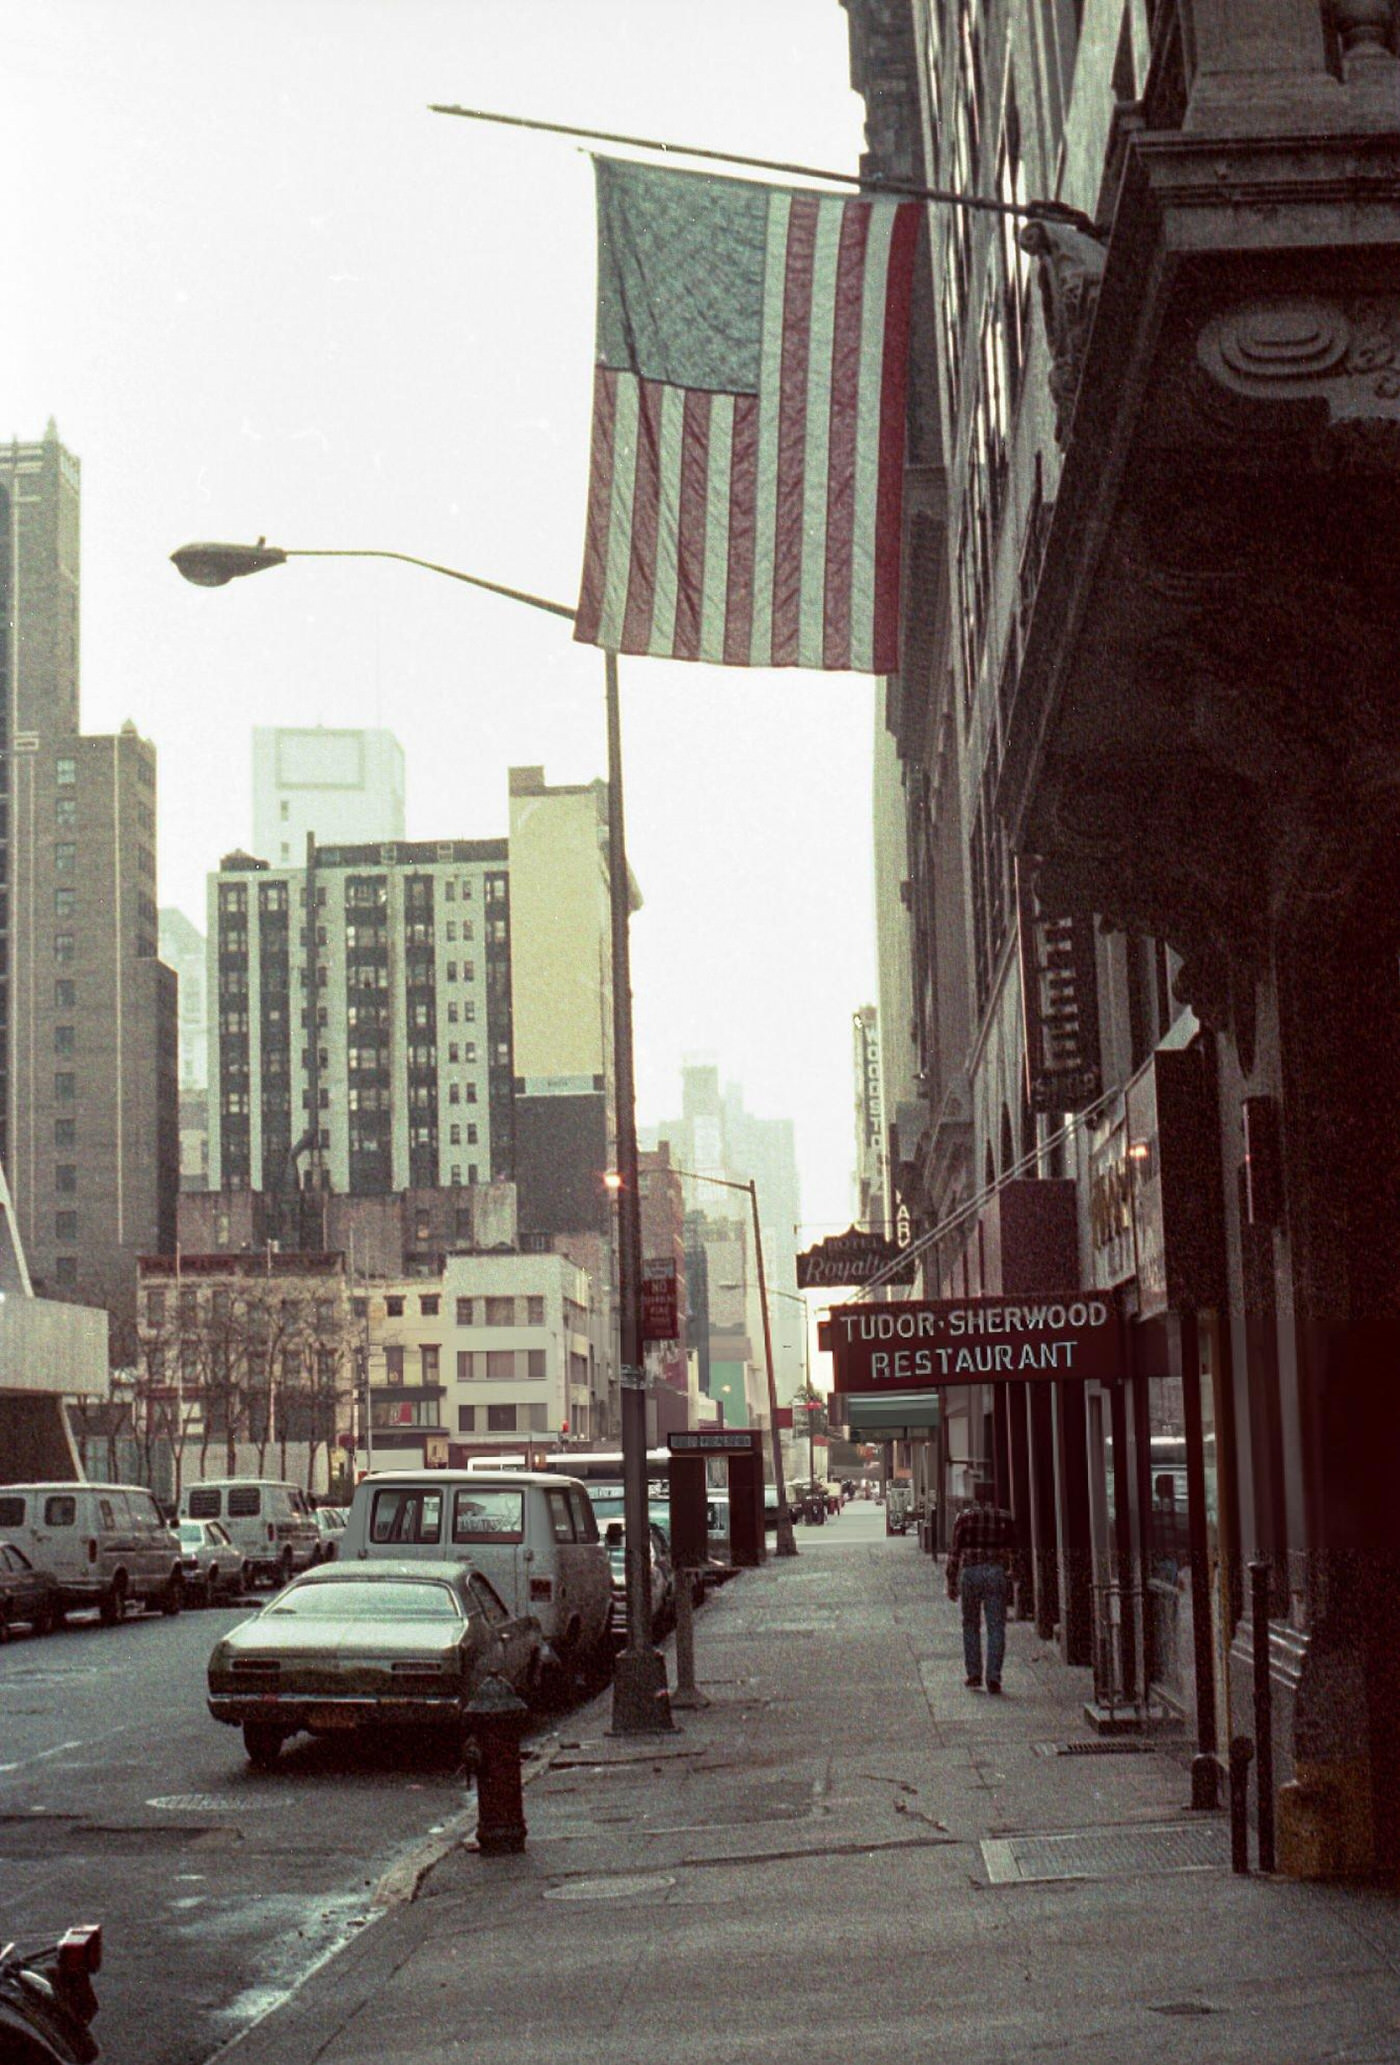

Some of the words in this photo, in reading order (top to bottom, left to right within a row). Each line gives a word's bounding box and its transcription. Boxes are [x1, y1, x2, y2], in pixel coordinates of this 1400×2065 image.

[805, 1254, 907, 1283] Royalto
[840, 1311, 935, 1342] TUDOR
[949, 1301, 1108, 1337] SHERWOOD
[872, 1341, 1079, 1379] RESTAURANT
